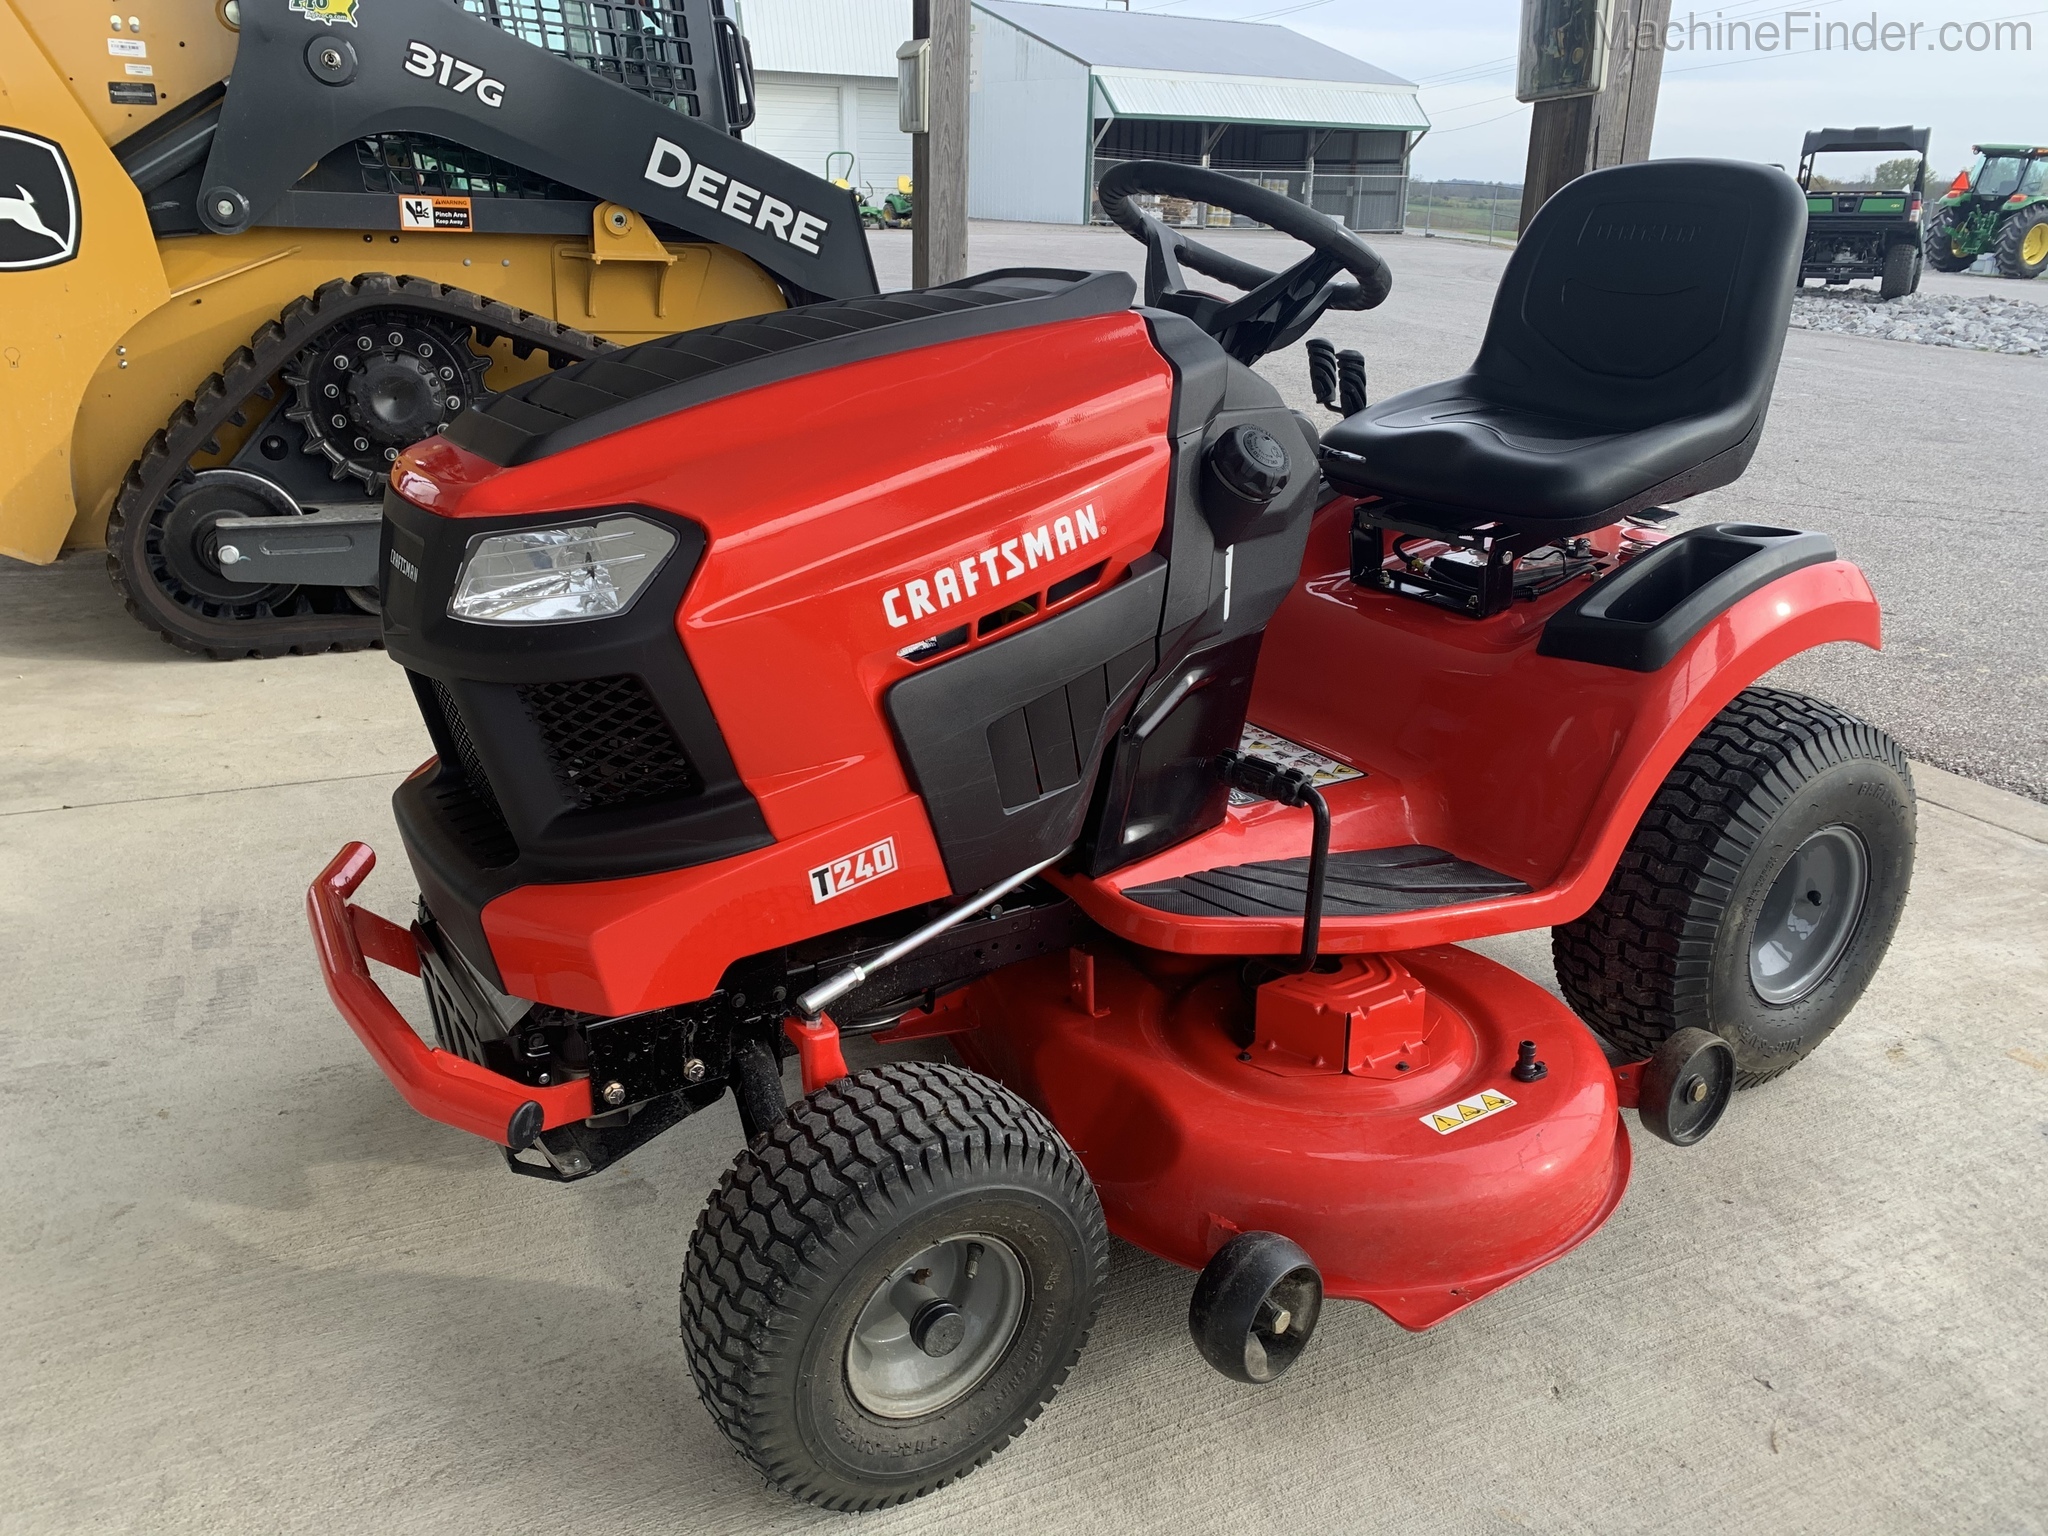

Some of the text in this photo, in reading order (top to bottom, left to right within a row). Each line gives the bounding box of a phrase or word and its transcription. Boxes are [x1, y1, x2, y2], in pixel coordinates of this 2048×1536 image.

[404, 41, 505, 108] 317G
[644, 136, 828, 255] DEERE
[390, 548, 419, 583] CRAFTSMAN
[882, 503, 1100, 629] CRAFTSMAN
[811, 842, 895, 898] T240
